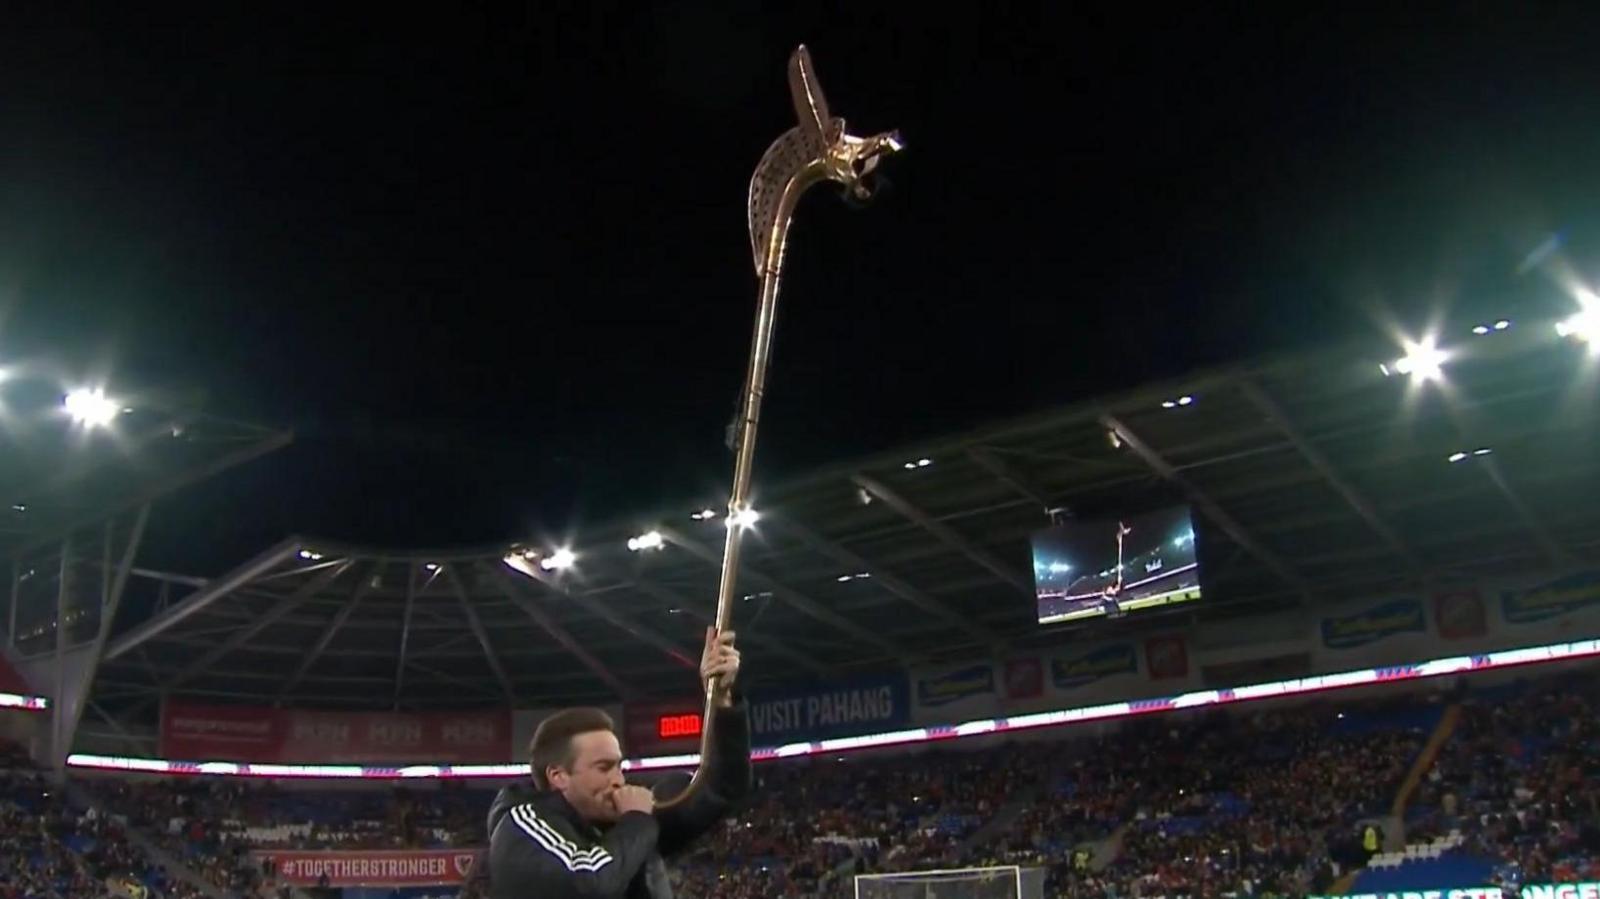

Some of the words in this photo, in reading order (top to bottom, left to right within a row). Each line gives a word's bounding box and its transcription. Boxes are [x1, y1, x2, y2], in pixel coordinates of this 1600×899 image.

[752, 698, 802, 734] VISIT
[808, 686, 893, 727] PAHANG
[283, 857, 447, 877] #TOGETHERSTRONGER
